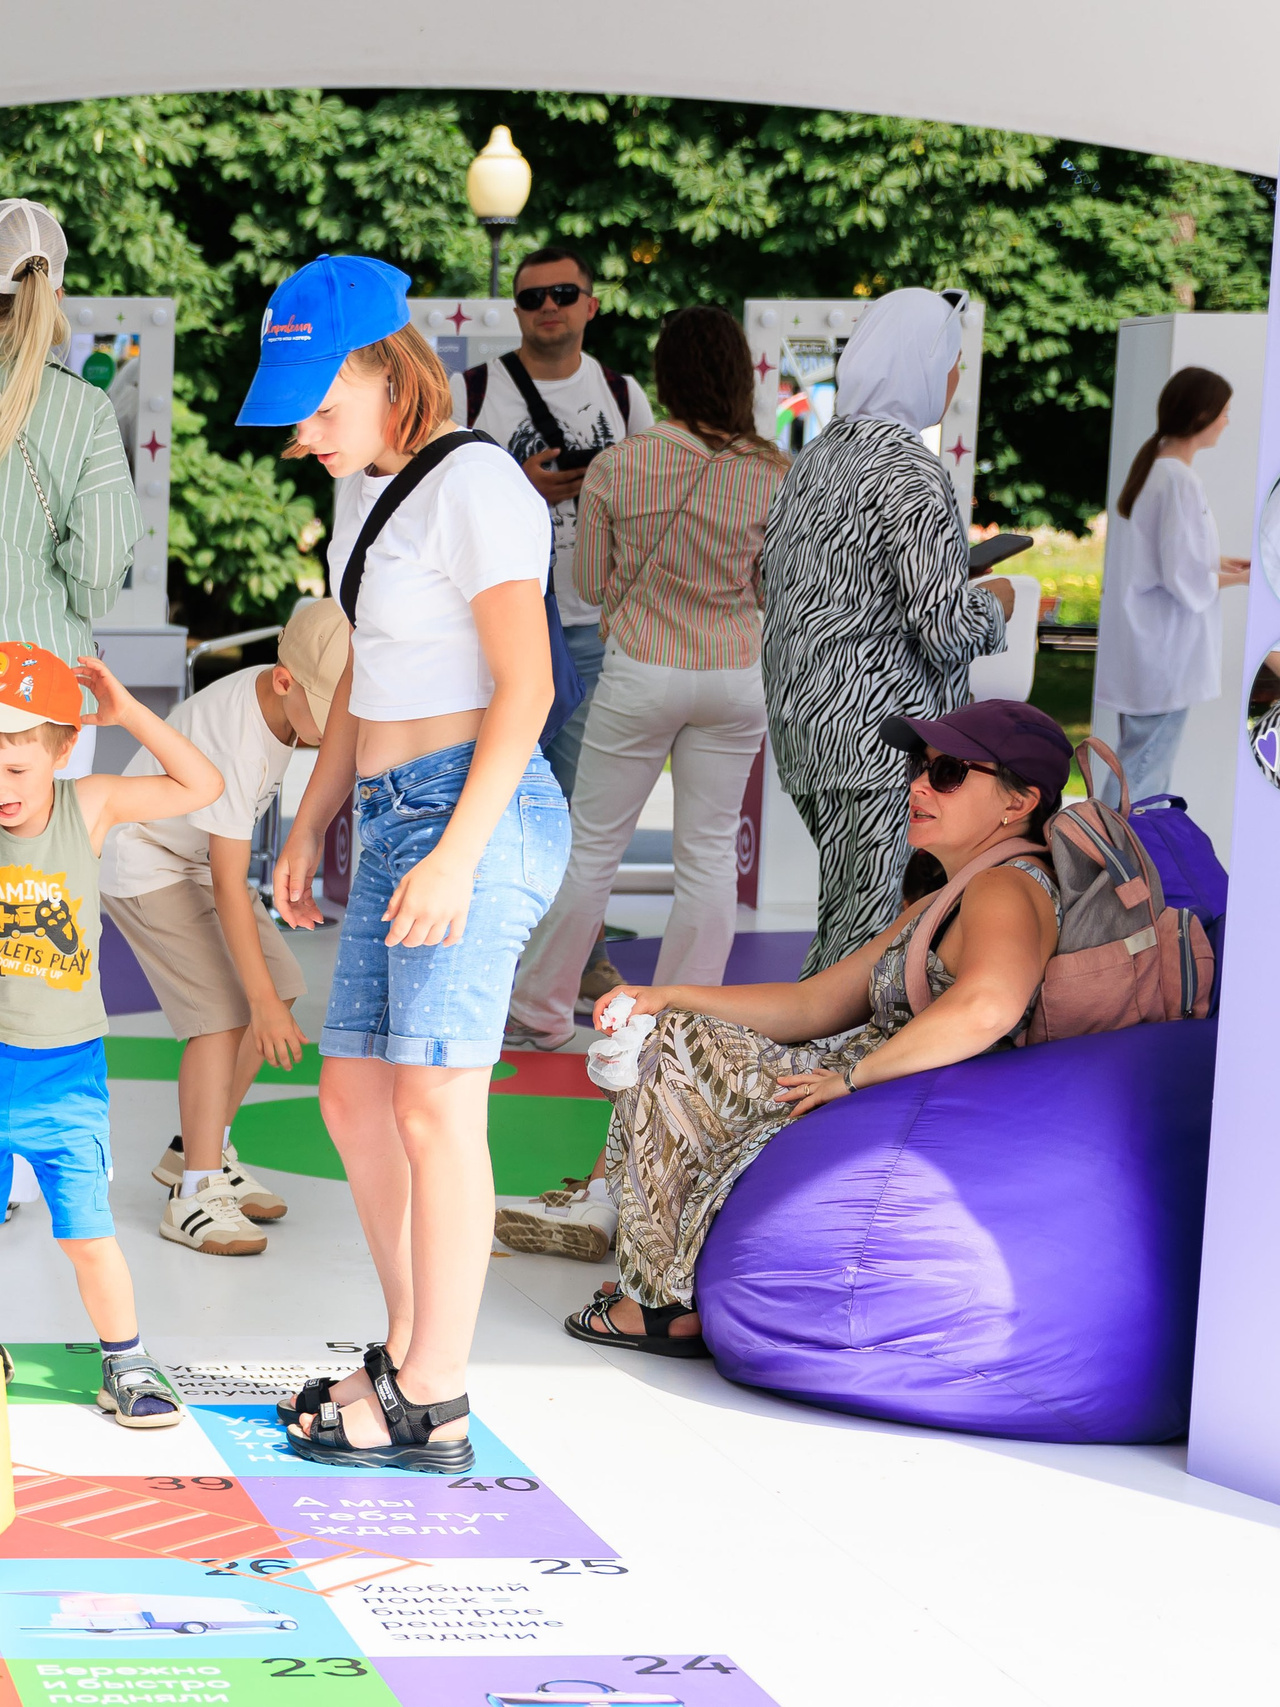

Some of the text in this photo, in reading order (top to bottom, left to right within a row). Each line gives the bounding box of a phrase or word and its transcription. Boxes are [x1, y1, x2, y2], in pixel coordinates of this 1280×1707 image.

[4, 941, 90, 975] LETS PLAY
[23, 964, 47, 977] GIVE
[50, 970, 63, 980] UP
[65, 1343, 100, 1354] 5
[164, 1365, 229, 1373] Ура!
[241, 1364, 305, 1372] Ещё
[183, 1389, 297, 1397] случил
[143, 1476, 234, 1491] 39
[446, 1476, 540, 1492] 40
[292, 1496, 416, 1508] А мы
[298, 1510, 509, 1523] тебя тут
[313, 1524, 482, 1536] ждали
[202, 1559, 297, 1575] 26
[530, 1559, 629, 1575] 25
[354, 1583, 530, 1594] Удобный
[371, 1607, 545, 1617] быстрое
[381, 1620, 564, 1630] решение
[390, 1632, 538, 1642] задачи
[35, 1664, 221, 1678] Бережно
[261, 1657, 368, 1677] 23
[621, 1655, 737, 1675] 24
[43, 1678, 231, 1691] и быстро
[48, 1693, 230, 1705] подняли
